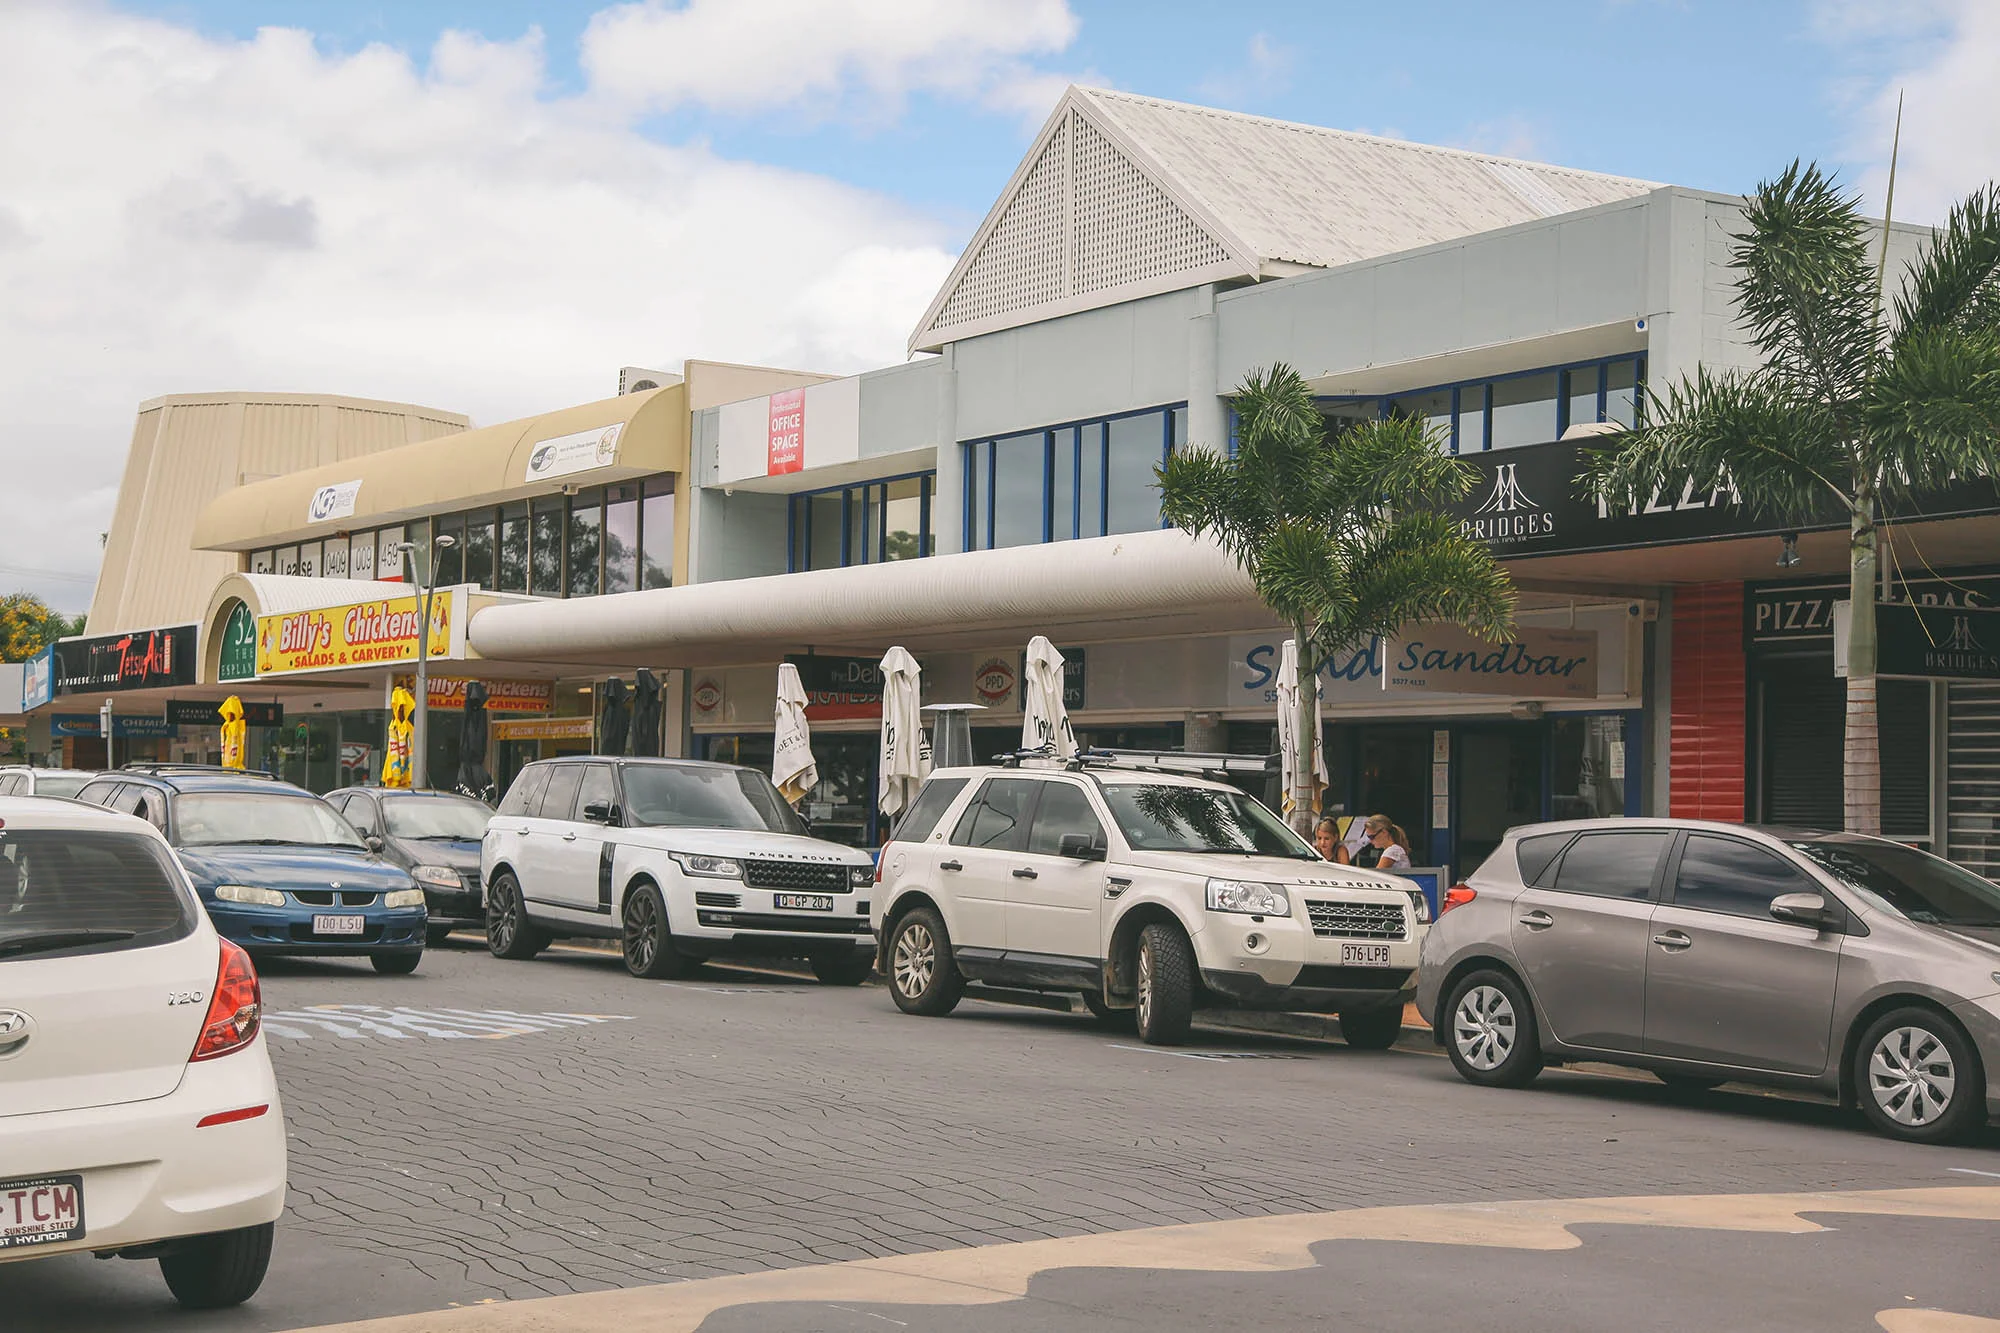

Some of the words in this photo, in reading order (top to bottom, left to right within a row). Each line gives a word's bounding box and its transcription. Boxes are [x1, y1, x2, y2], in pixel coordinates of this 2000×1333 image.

[772, 413, 801, 432] OFFICE
[772, 433, 799, 452] SPACE
[773, 453, 797, 465] Available
[1598, 458, 1743, 519] IZZA
[1461, 512, 1553, 540] BRIDGES
[257, 562, 272, 576] For
[281, 559, 313, 578] Lease
[325, 550, 346, 576] 0409
[355, 546, 372, 571] 009
[381, 543, 398, 567] 459
[235, 606, 254, 646] 32
[280, 613, 332, 654] Billy's
[344, 602, 421, 646] Chickens
[235, 648, 254, 661] THE
[294, 651, 335, 669] SALADS
[338, 653, 347, 664] &
[352, 645, 404, 662] CARVERY
[1399, 641, 1587, 677] Sandbar
[427, 679, 468, 697] illy's
[986, 676, 1004, 689] PPD
[488, 701, 545, 711] CARVERY
[749, 851, 793, 859] RANGE
[1298, 878, 1339, 886] LAND
[1347, 880, 1393, 889] ROVER
[168, 991, 204, 1006] i20
[4, 1223, 46, 1236] SUNSHINE
[50, 1220, 75, 1231] STATE
[16, 1231, 68, 1245] HYUNDAI
